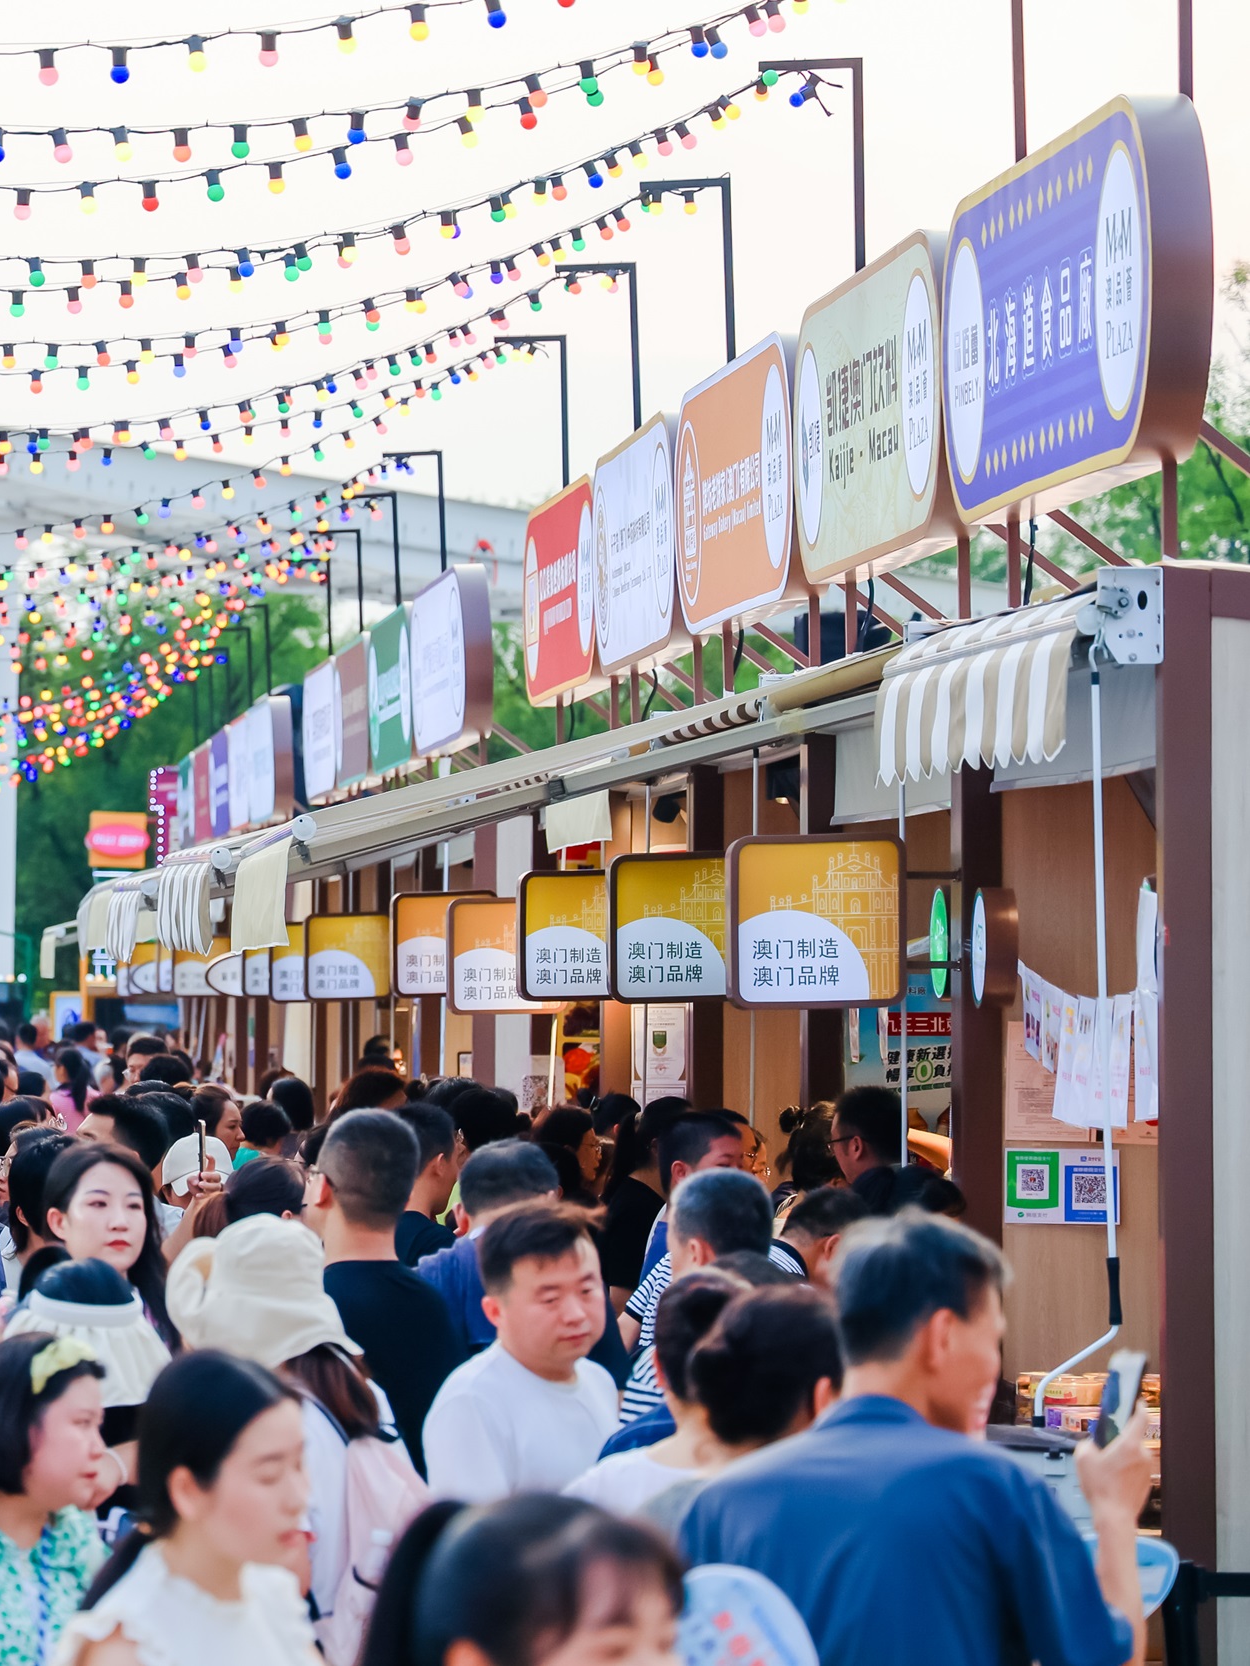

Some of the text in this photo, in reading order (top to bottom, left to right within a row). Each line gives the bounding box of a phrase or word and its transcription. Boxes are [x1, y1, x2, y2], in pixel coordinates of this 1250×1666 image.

[828, 441, 854, 490] Kaijie
[869, 424, 899, 465] Macau
[535, 947, 602, 964] 澳门制造
[628, 941, 703, 960] 澳门制造
[752, 938, 839, 960] 澳门制造
[316, 965, 359, 976] 澳门制造
[535, 968, 602, 985] 澳门品牌
[628, 964, 703, 983] 澳门品牌
[753, 965, 840, 987] 澳门品牌
[316, 978, 360, 990] 澳门品牌
[887, 1044, 951, 1066] 健康新選
